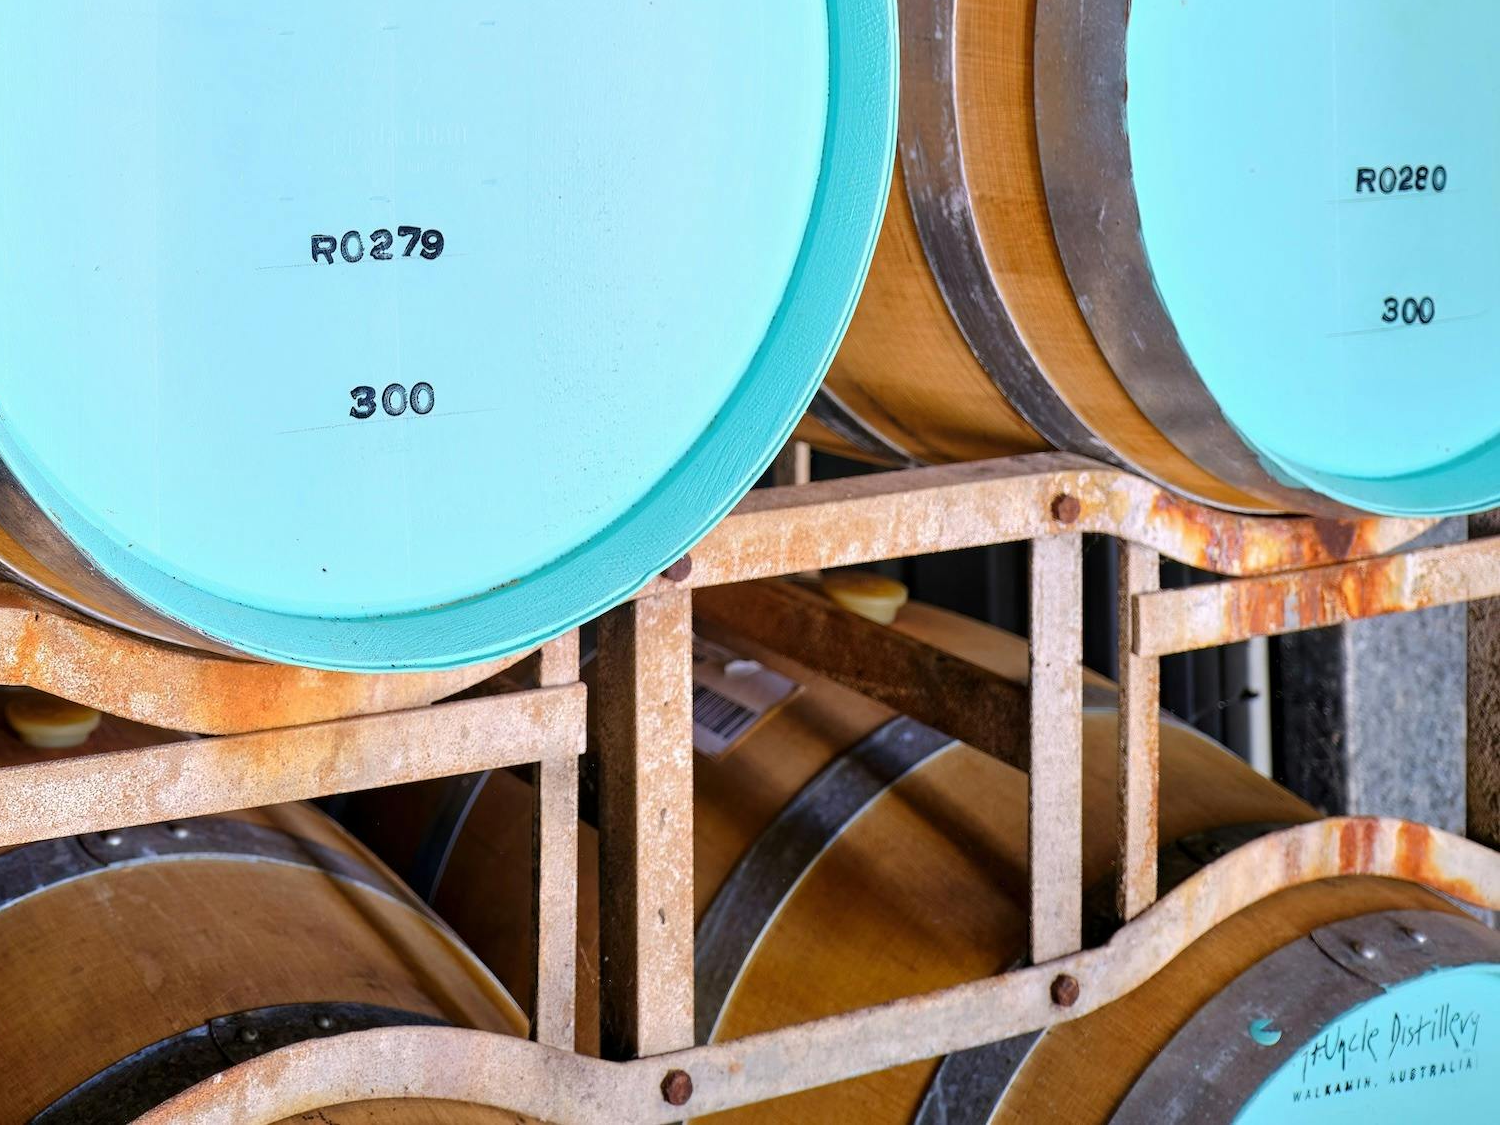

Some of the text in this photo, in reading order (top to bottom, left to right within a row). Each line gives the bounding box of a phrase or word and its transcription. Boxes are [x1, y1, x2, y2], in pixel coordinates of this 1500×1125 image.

[310, 225, 445, 265] R0279
[1381, 296, 1435, 325] 300
[348, 381, 435, 420] 300
[1388, 1002, 1481, 1058] Distillery
[1389, 1057, 1473, 1084] AUSTRALIA
